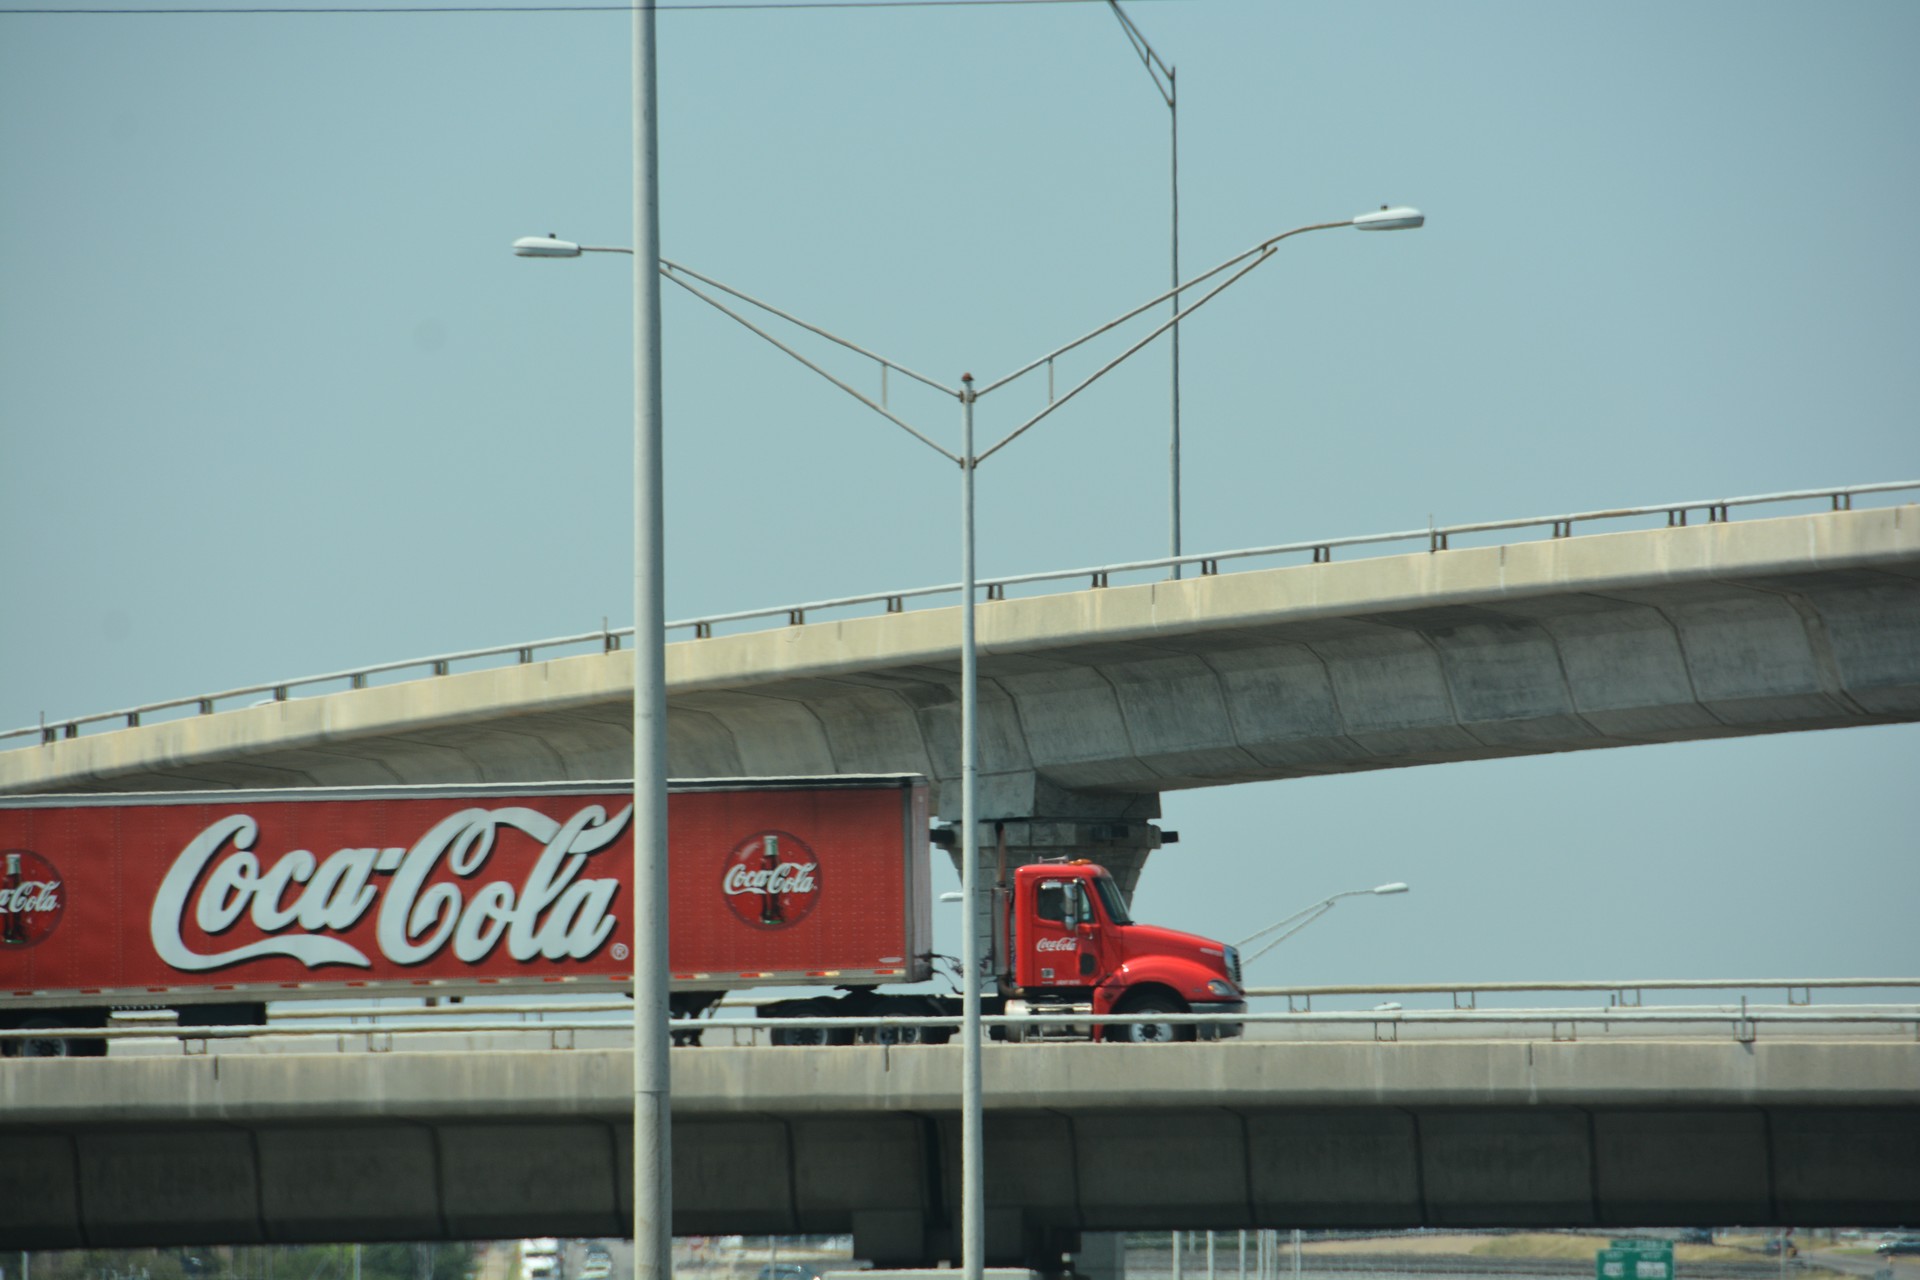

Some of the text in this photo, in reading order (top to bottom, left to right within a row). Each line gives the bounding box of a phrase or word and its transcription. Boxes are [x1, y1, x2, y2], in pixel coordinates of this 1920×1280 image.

[150, 803, 634, 970] Coca-Cola
[723, 862, 818, 895] Coca-Cola
[0, 880, 61, 913] a-Cola
[1036, 936, 1078, 953] Coca-Cola
